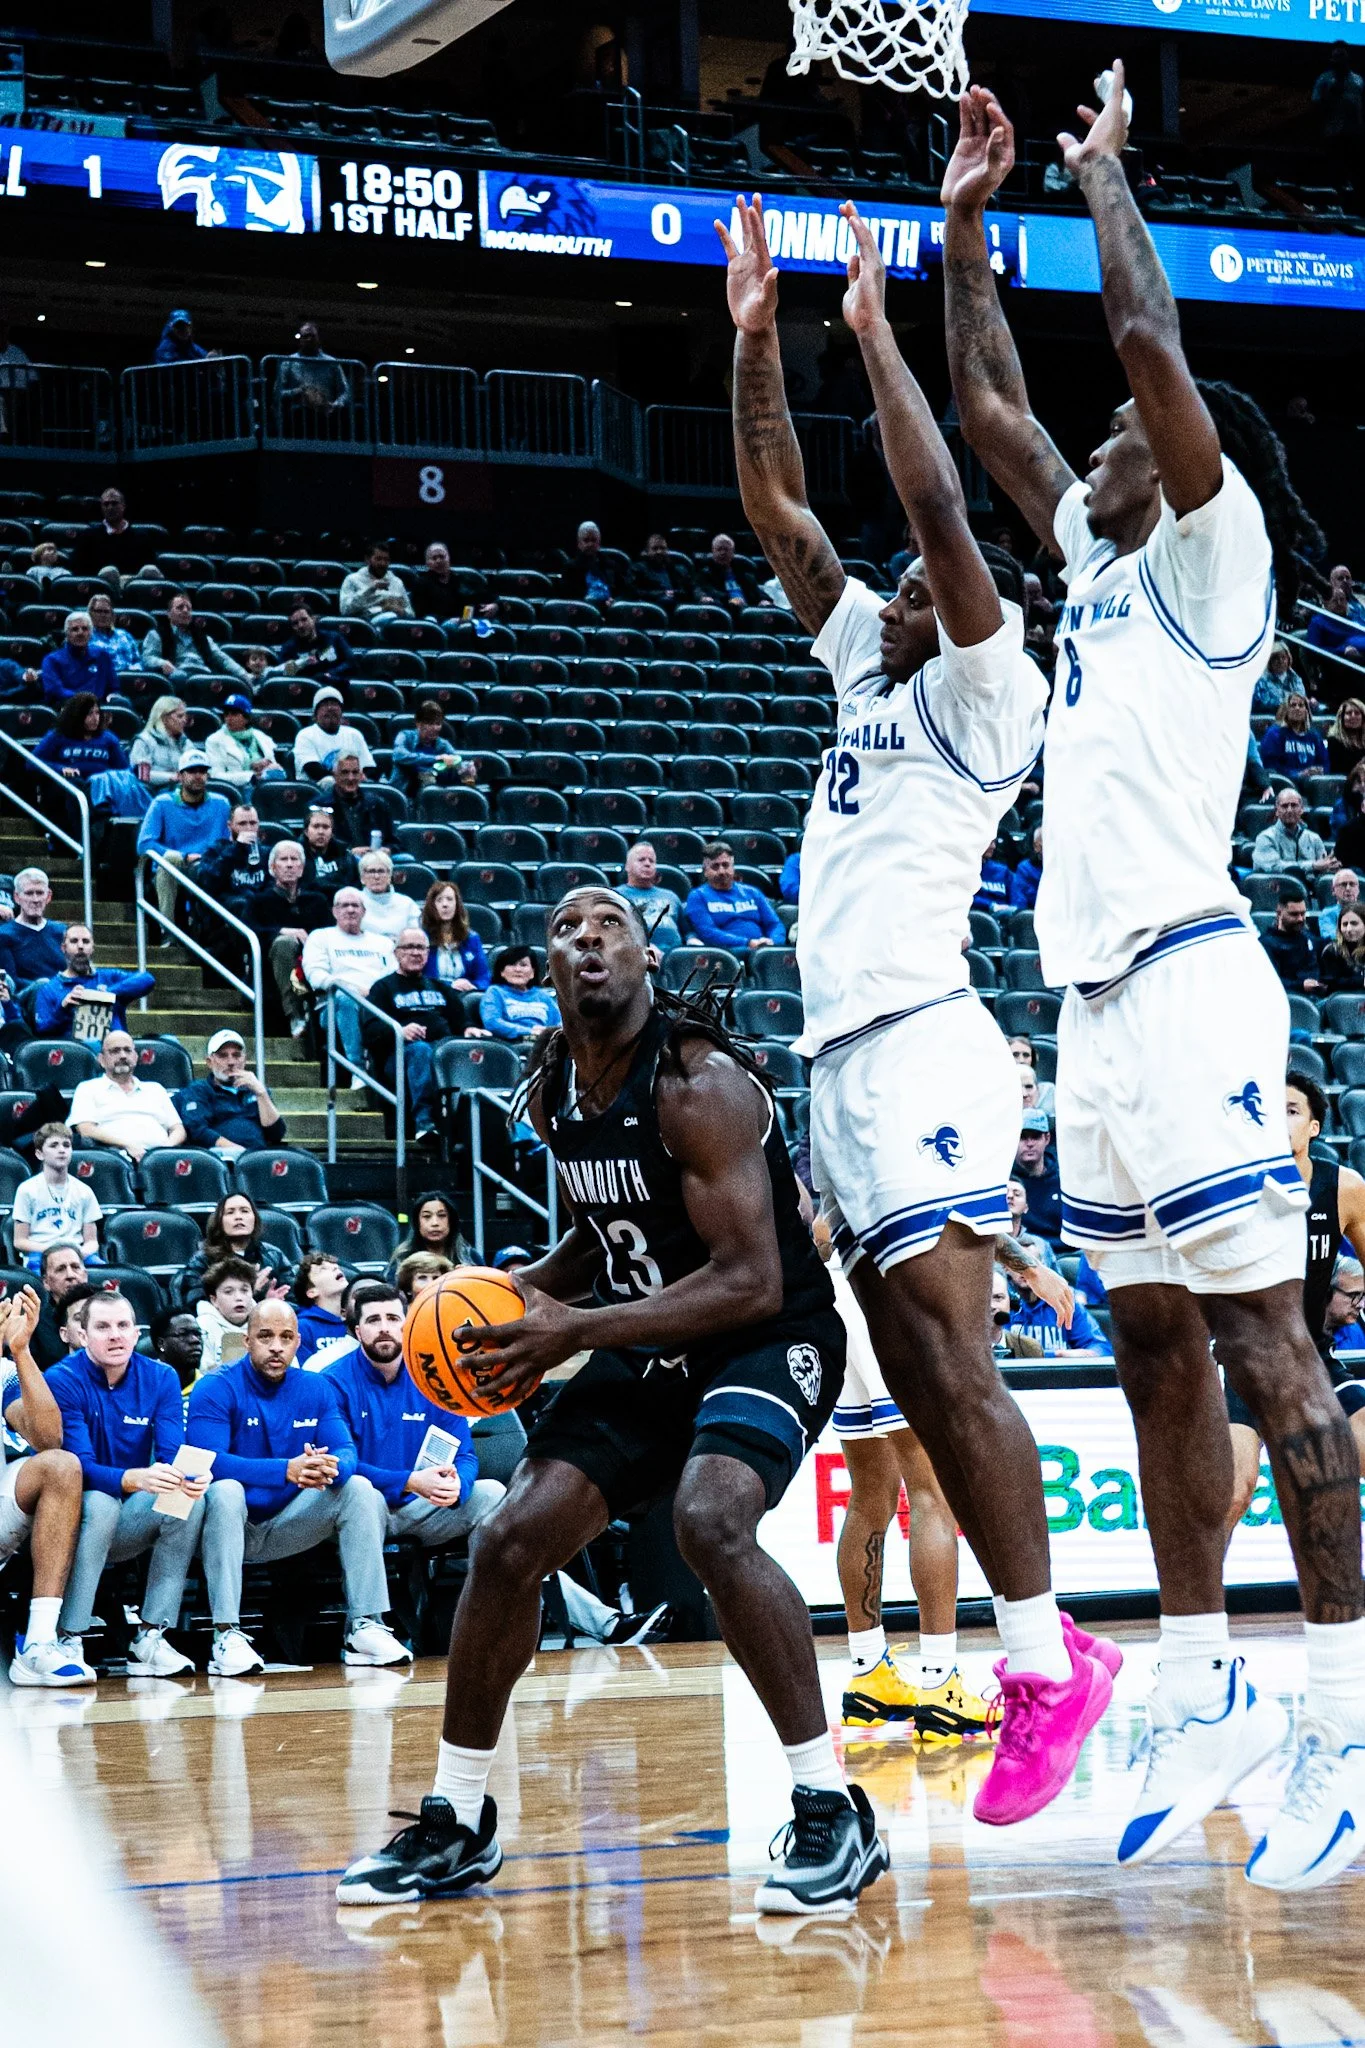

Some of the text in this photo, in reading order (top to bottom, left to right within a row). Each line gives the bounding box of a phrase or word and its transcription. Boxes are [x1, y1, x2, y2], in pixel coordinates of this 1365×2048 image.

[83, 155, 102, 198] 1
[340, 162, 463, 209] 18:50
[330, 203, 473, 241] 1ST HALF
[651, 203, 682, 244] 0
[485, 230, 613, 257] MONMOUTH
[1246, 257, 1293, 275] PETER
[1313, 262, 1354, 279] DAVIS
[419, 466, 446, 503] 8
[1063, 637, 1083, 707] 6
[826, 749, 860, 815] 22
[415, 1352, 464, 1411] NCAA
